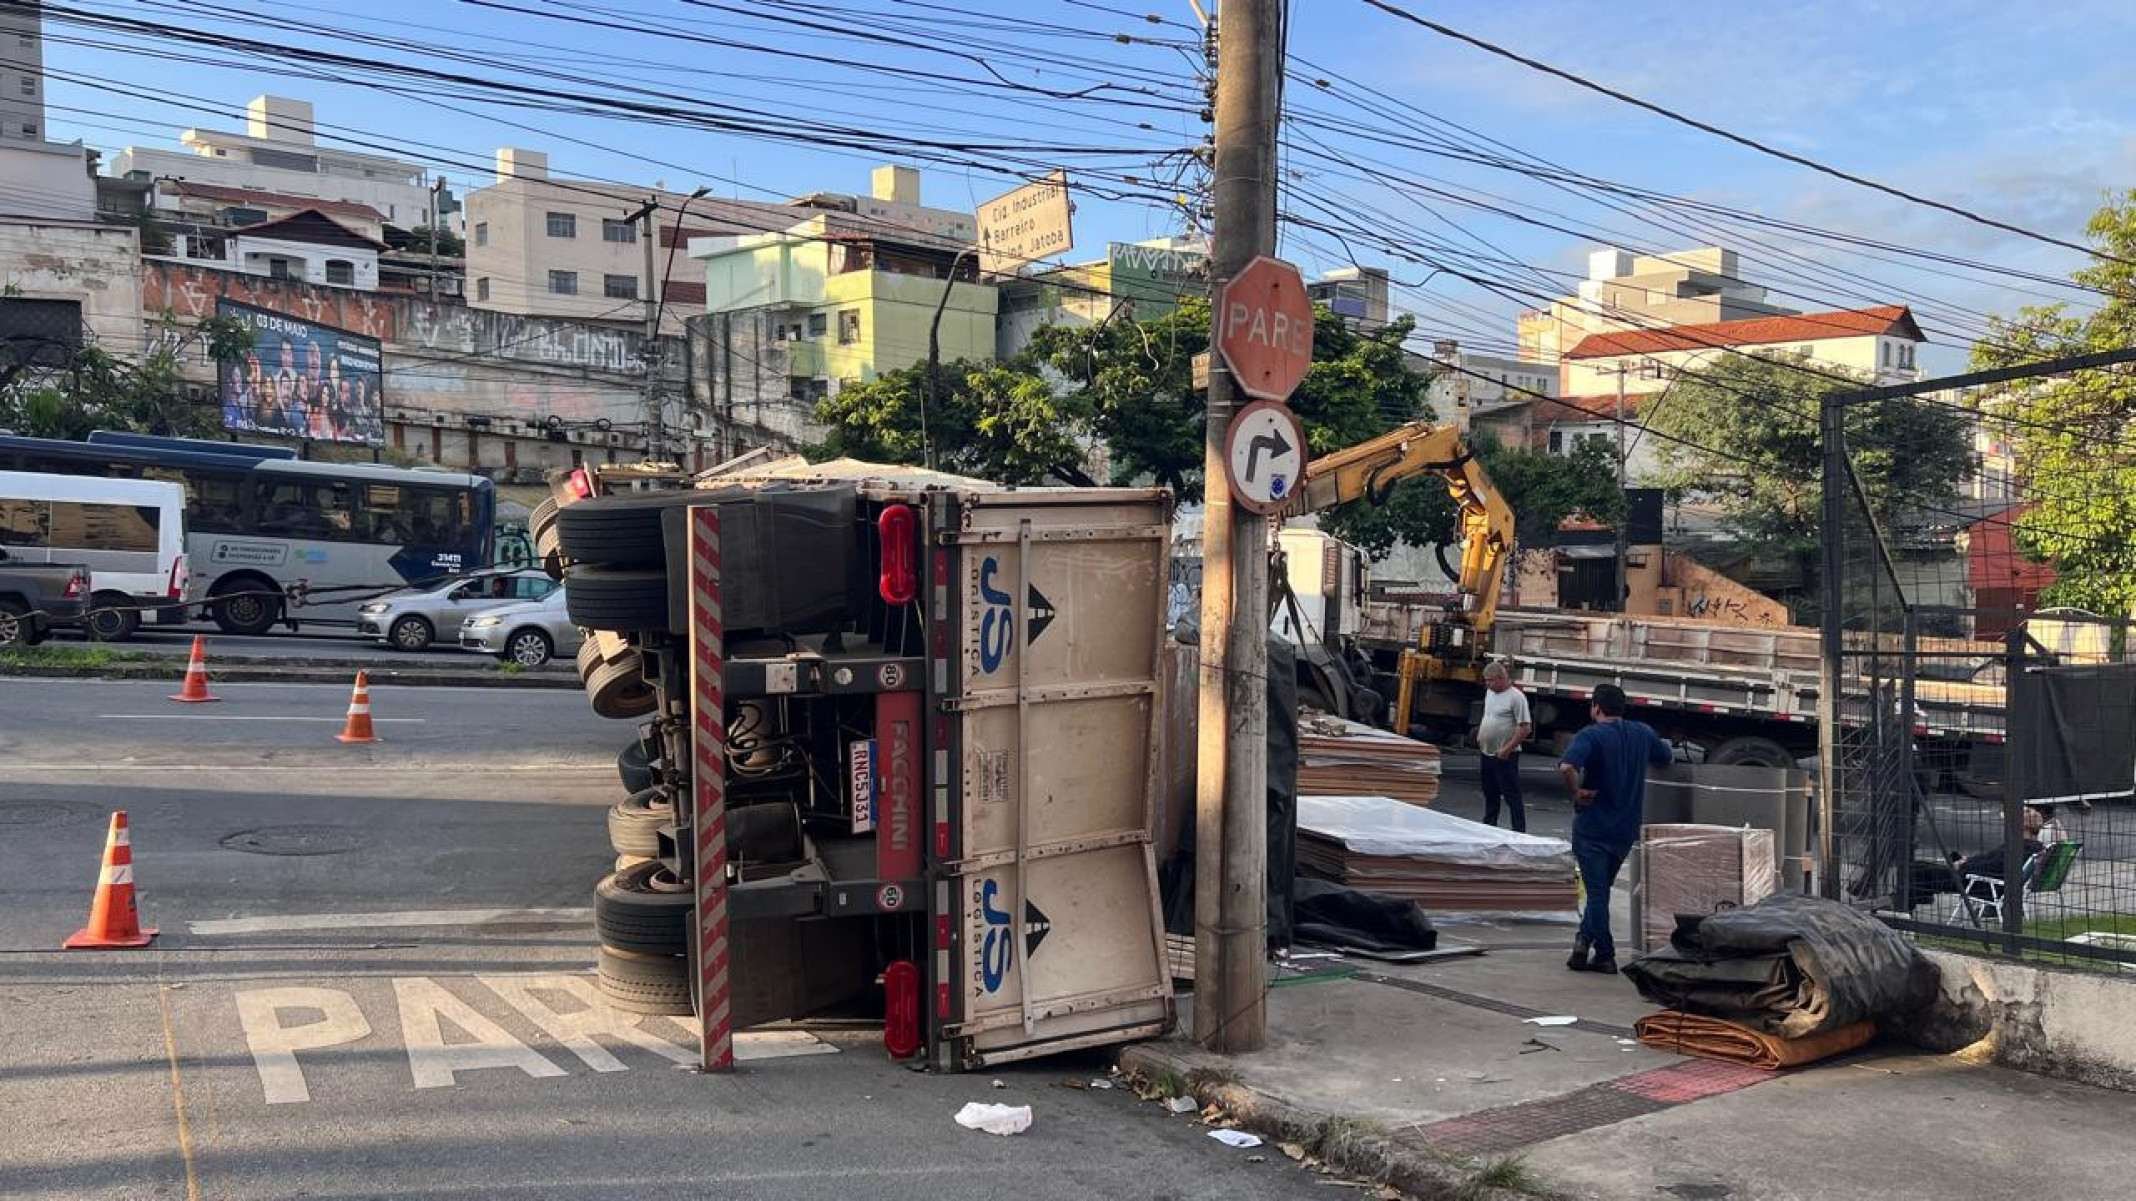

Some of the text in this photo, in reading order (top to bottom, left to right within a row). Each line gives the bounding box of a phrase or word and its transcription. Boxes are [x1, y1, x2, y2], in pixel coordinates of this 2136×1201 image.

[1013, 181, 1059, 213] Industrial
[994, 218, 1035, 244] Barreiro
[256, 314, 308, 338] 03 DE MAIO
[1227, 302, 1304, 356] PARE
[981, 556, 1013, 674] JS
[885, 664, 897, 685] 80
[854, 750, 869, 823] RNC5J31
[892, 720, 910, 850] FACCHINI
[886, 886, 897, 907] 60
[973, 879, 983, 997] LOGISTICA
[982, 879, 1012, 993] JS
